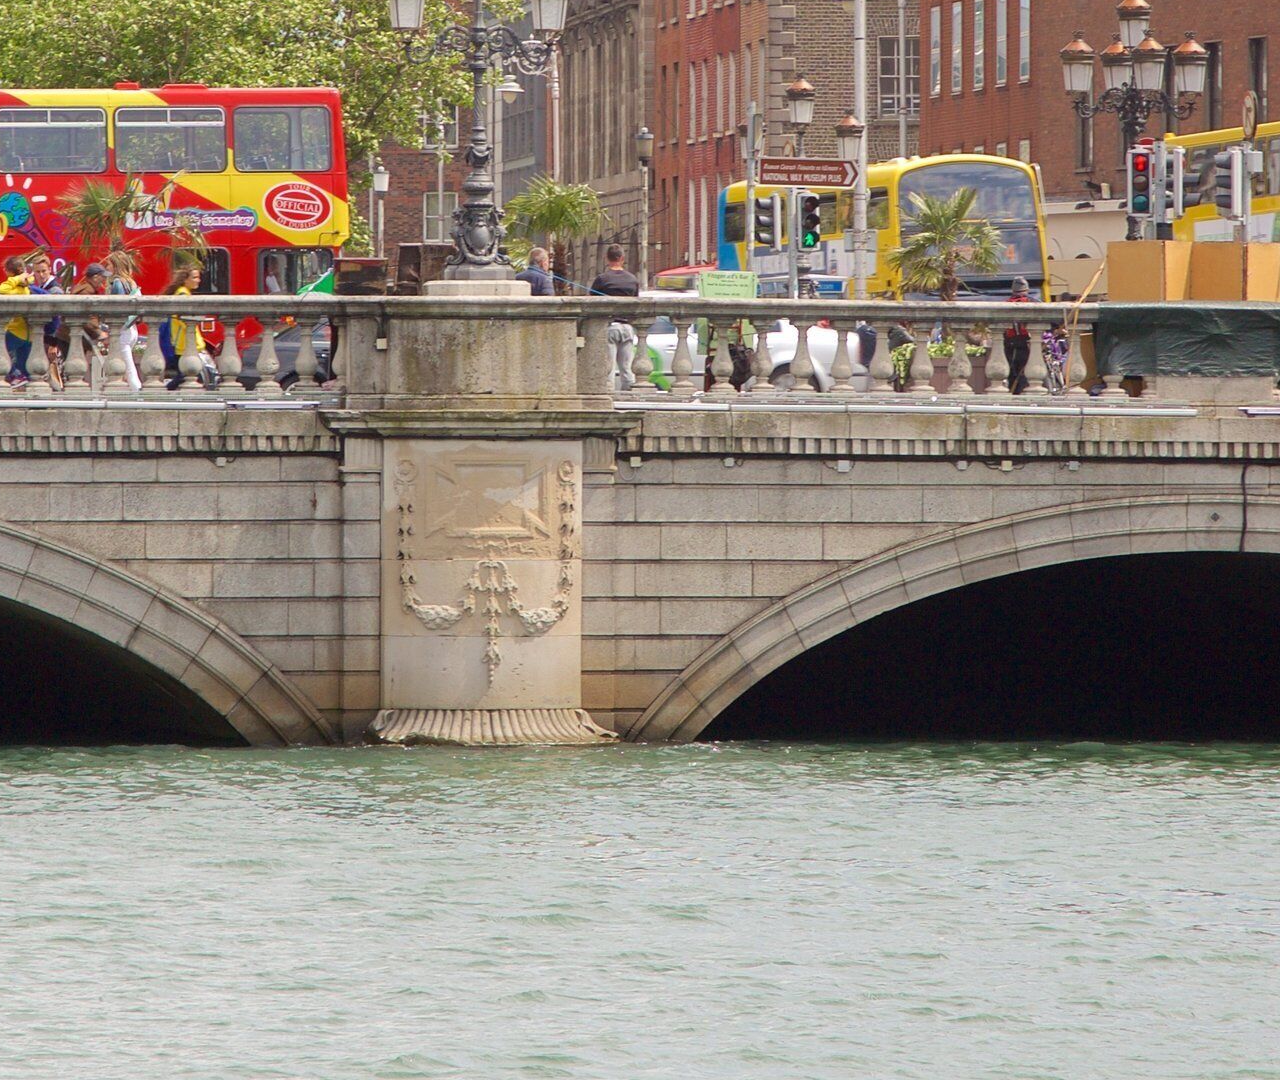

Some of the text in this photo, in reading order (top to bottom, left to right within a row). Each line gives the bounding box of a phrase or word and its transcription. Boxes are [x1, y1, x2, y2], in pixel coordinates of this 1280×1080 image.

[288, 184, 311, 192] TOUR
[276, 199, 320, 213] OFFICIAL
[288, 220, 318, 229] DUBLIN
